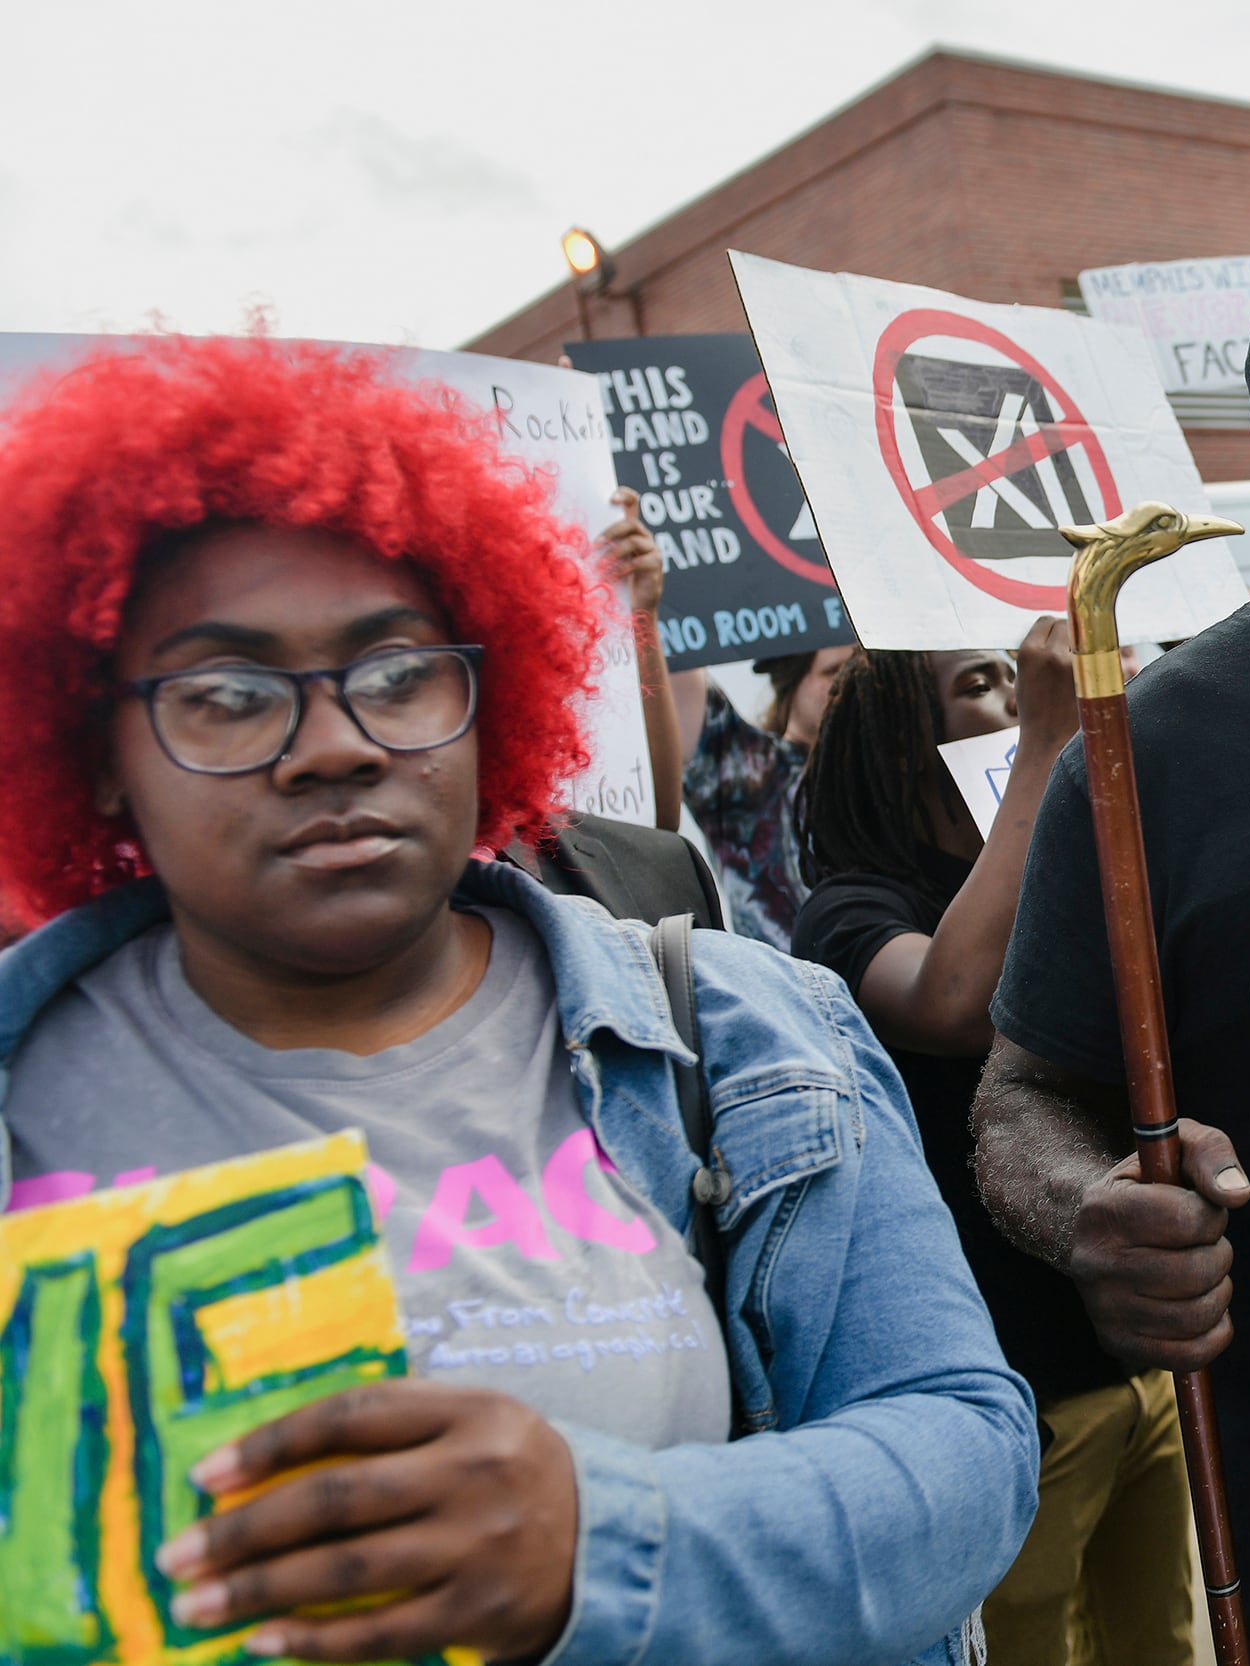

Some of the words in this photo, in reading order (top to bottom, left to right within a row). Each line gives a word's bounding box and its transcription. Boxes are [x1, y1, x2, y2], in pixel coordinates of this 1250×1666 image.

[1173, 338, 1250, 384] FAC
[599, 366, 693, 414] THIS
[606, 410, 709, 453] LAND
[641, 451, 681, 488] IS
[639, 485, 723, 527] OUR
[655, 527, 741, 574] AND
[659, 616, 707, 657] NO
[714, 602, 807, 648] ROOM
